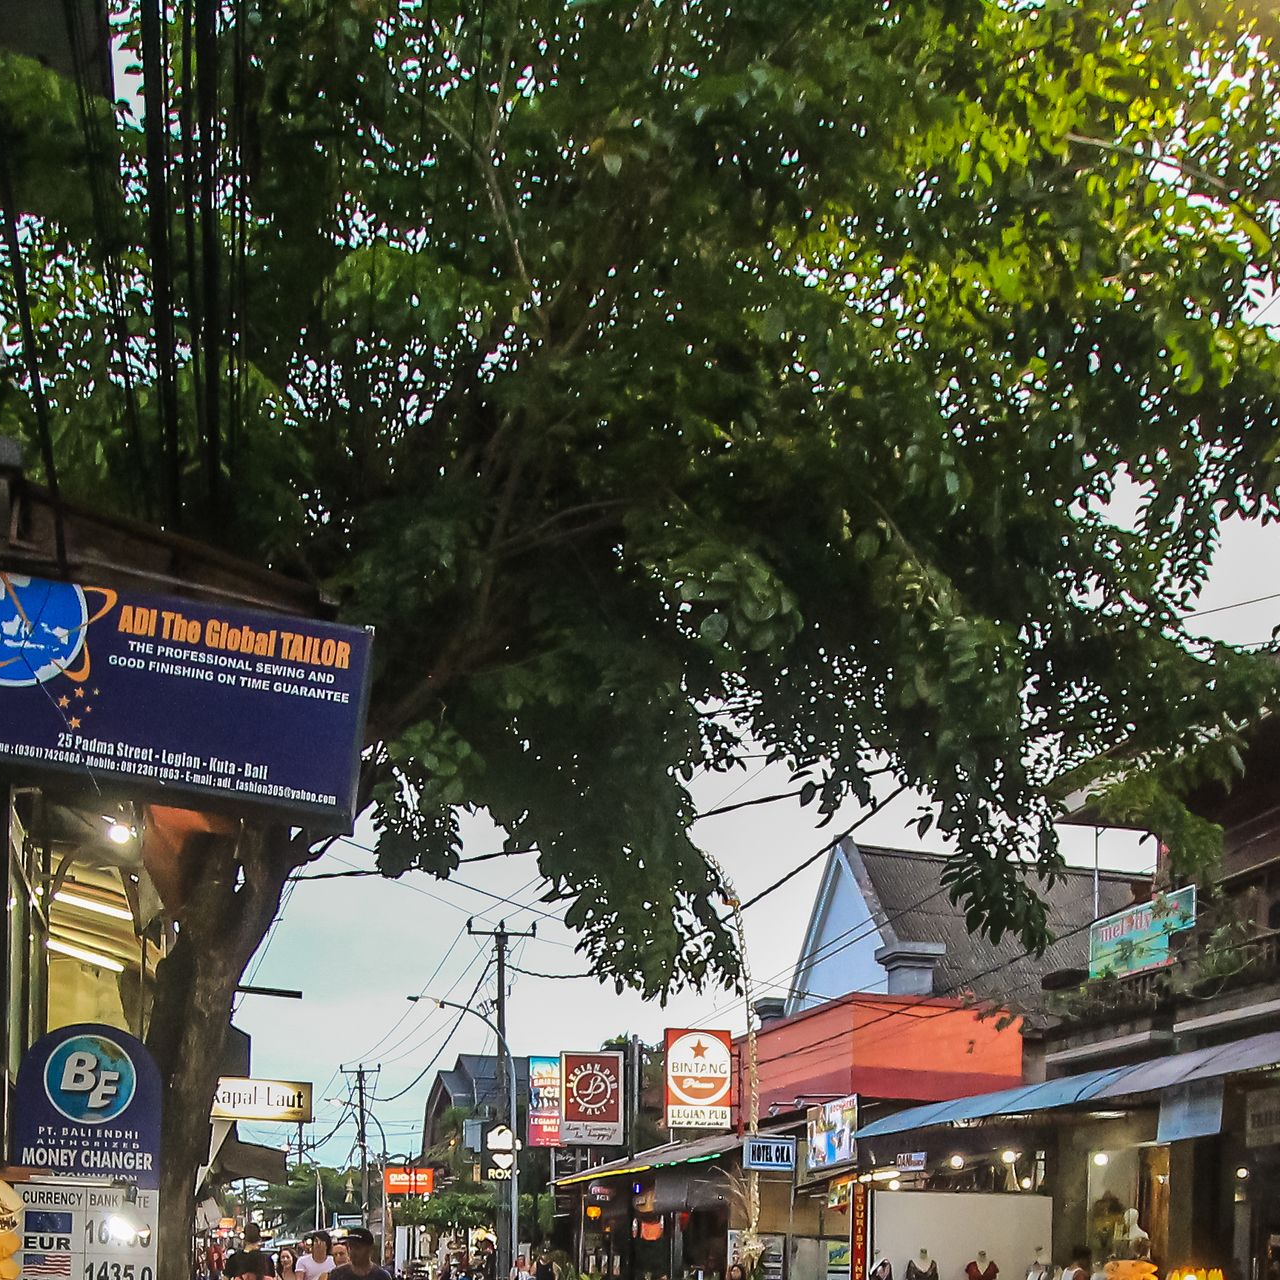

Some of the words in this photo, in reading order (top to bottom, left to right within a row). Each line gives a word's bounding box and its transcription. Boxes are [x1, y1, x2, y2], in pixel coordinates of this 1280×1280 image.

[117, 604, 158, 638] ADI
[161, 610, 202, 645] The
[205, 618, 277, 658] Global
[280, 631, 352, 670] TAILOR
[128, 640, 154, 655] THE
[157, 645, 253, 672] PROFESSIONAL
[255, 661, 305, 680] SEWING
[307, 670, 335, 684] AND
[108, 654, 146, 672] GOOD
[148, 661, 214, 682] FINISHING
[217, 673, 236, 686] ON
[239, 676, 271, 692] TIME
[273, 682, 350, 704] GUARANTEE
[57, 732, 73, 749] 25
[74, 735, 114, 756] Padma
[116, 741, 154, 762] Street
[162, 749, 201, 770] Legian
[209, 757, 236, 775] Kuta
[244, 763, 268, 780] Bali
[671, 1061, 728, 1075] BINTANG
[671, 1109, 705, 1119] LEGIAN
[708, 1109, 727, 1120] PUB
[62, 1127, 92, 1137] BALI
[96, 1129, 139, 1140] ENDHI
[37, 1138, 140, 1149] AUTHORIZED
[22, 1147, 77, 1167] MONEY
[81, 1150, 153, 1171] CHANGER
[751, 1144, 772, 1163] HOTEL
[775, 1144, 792, 1163] OKA
[487, 1168, 521, 1180] ROX
[22, 1190, 83, 1206] CURRENCY
[89, 1193, 119, 1207] BANK
[23, 1236, 71, 1250] EUR
